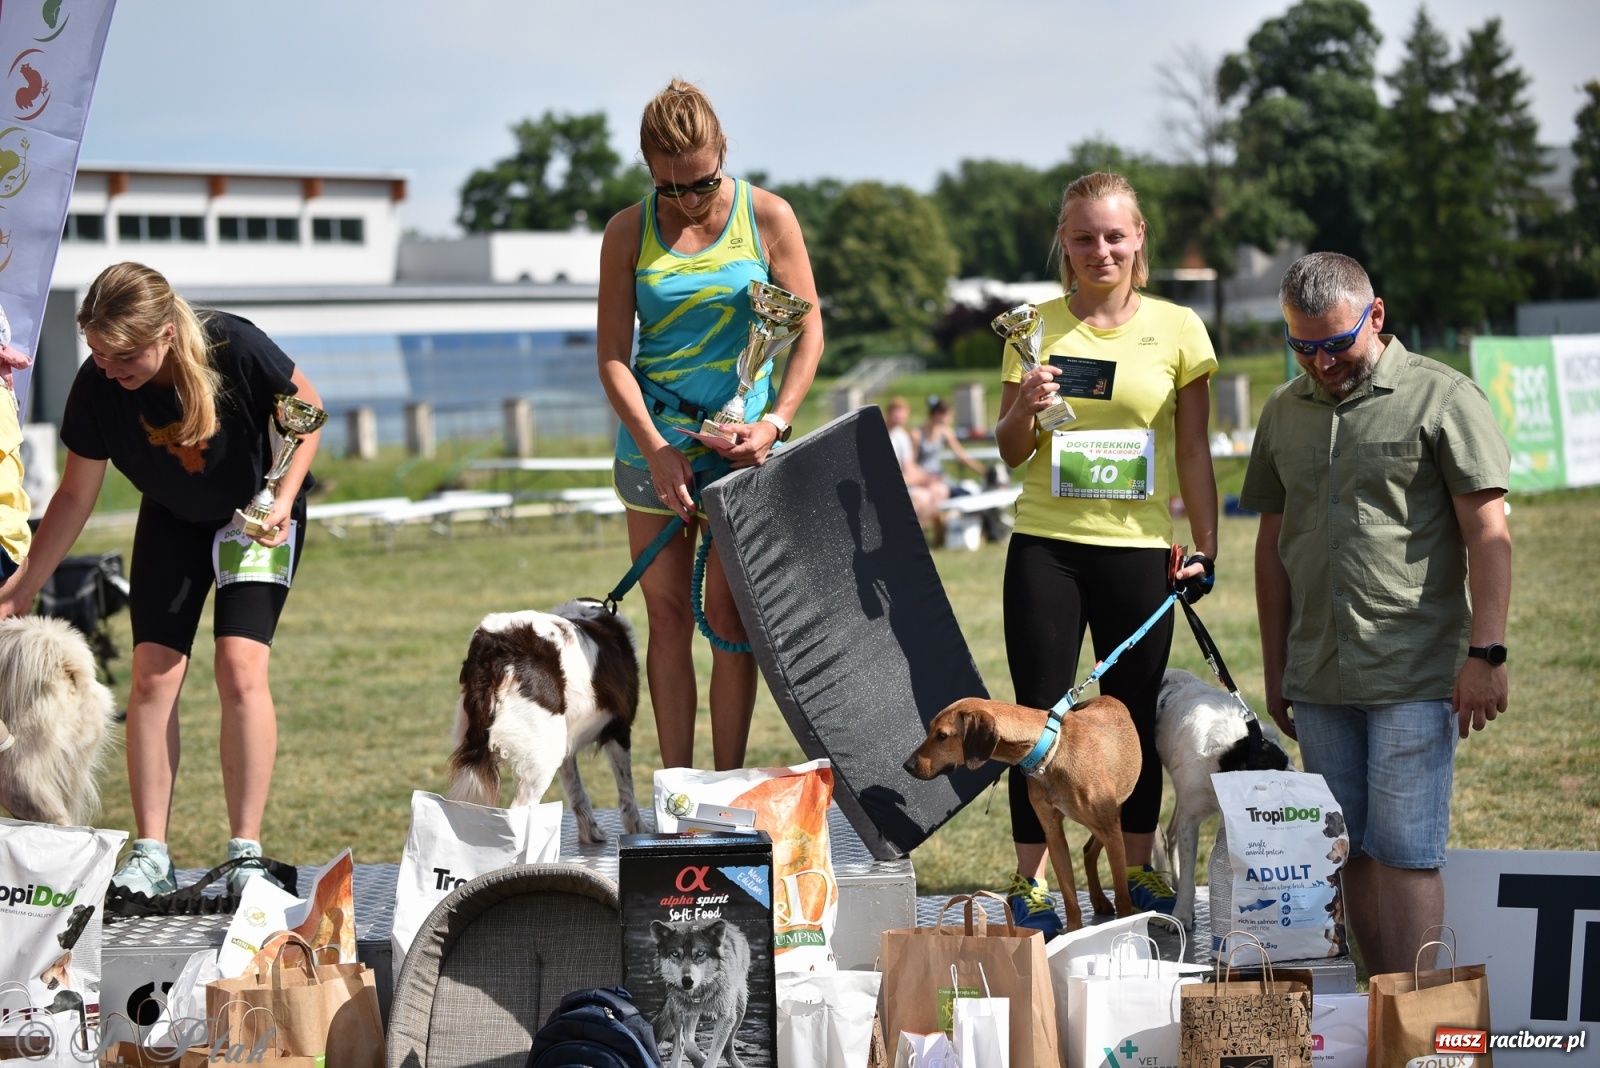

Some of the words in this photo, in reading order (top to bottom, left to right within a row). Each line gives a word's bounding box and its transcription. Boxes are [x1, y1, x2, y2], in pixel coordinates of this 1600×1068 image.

[1066, 441, 1141, 449] DOGTREKKING
[1090, 465, 1118, 484] 10
[223, 529, 242, 539] DOG
[240, 549, 271, 567] 22
[1245, 806, 1320, 825] TropiDog
[1247, 840, 1266, 850] single
[748, 868, 765, 884] New
[1246, 865, 1311, 882] ADULT
[737, 873, 763, 896] Edition
[660, 895, 694, 907] alpha
[696, 894, 729, 907] spirit
[0, 908, 26, 916] REMIUM
[669, 908, 692, 923] Soft
[694, 907, 722, 921] Food
[774, 932, 824, 946] UMPKIN
[1138, 1057, 1159, 1065] VET
